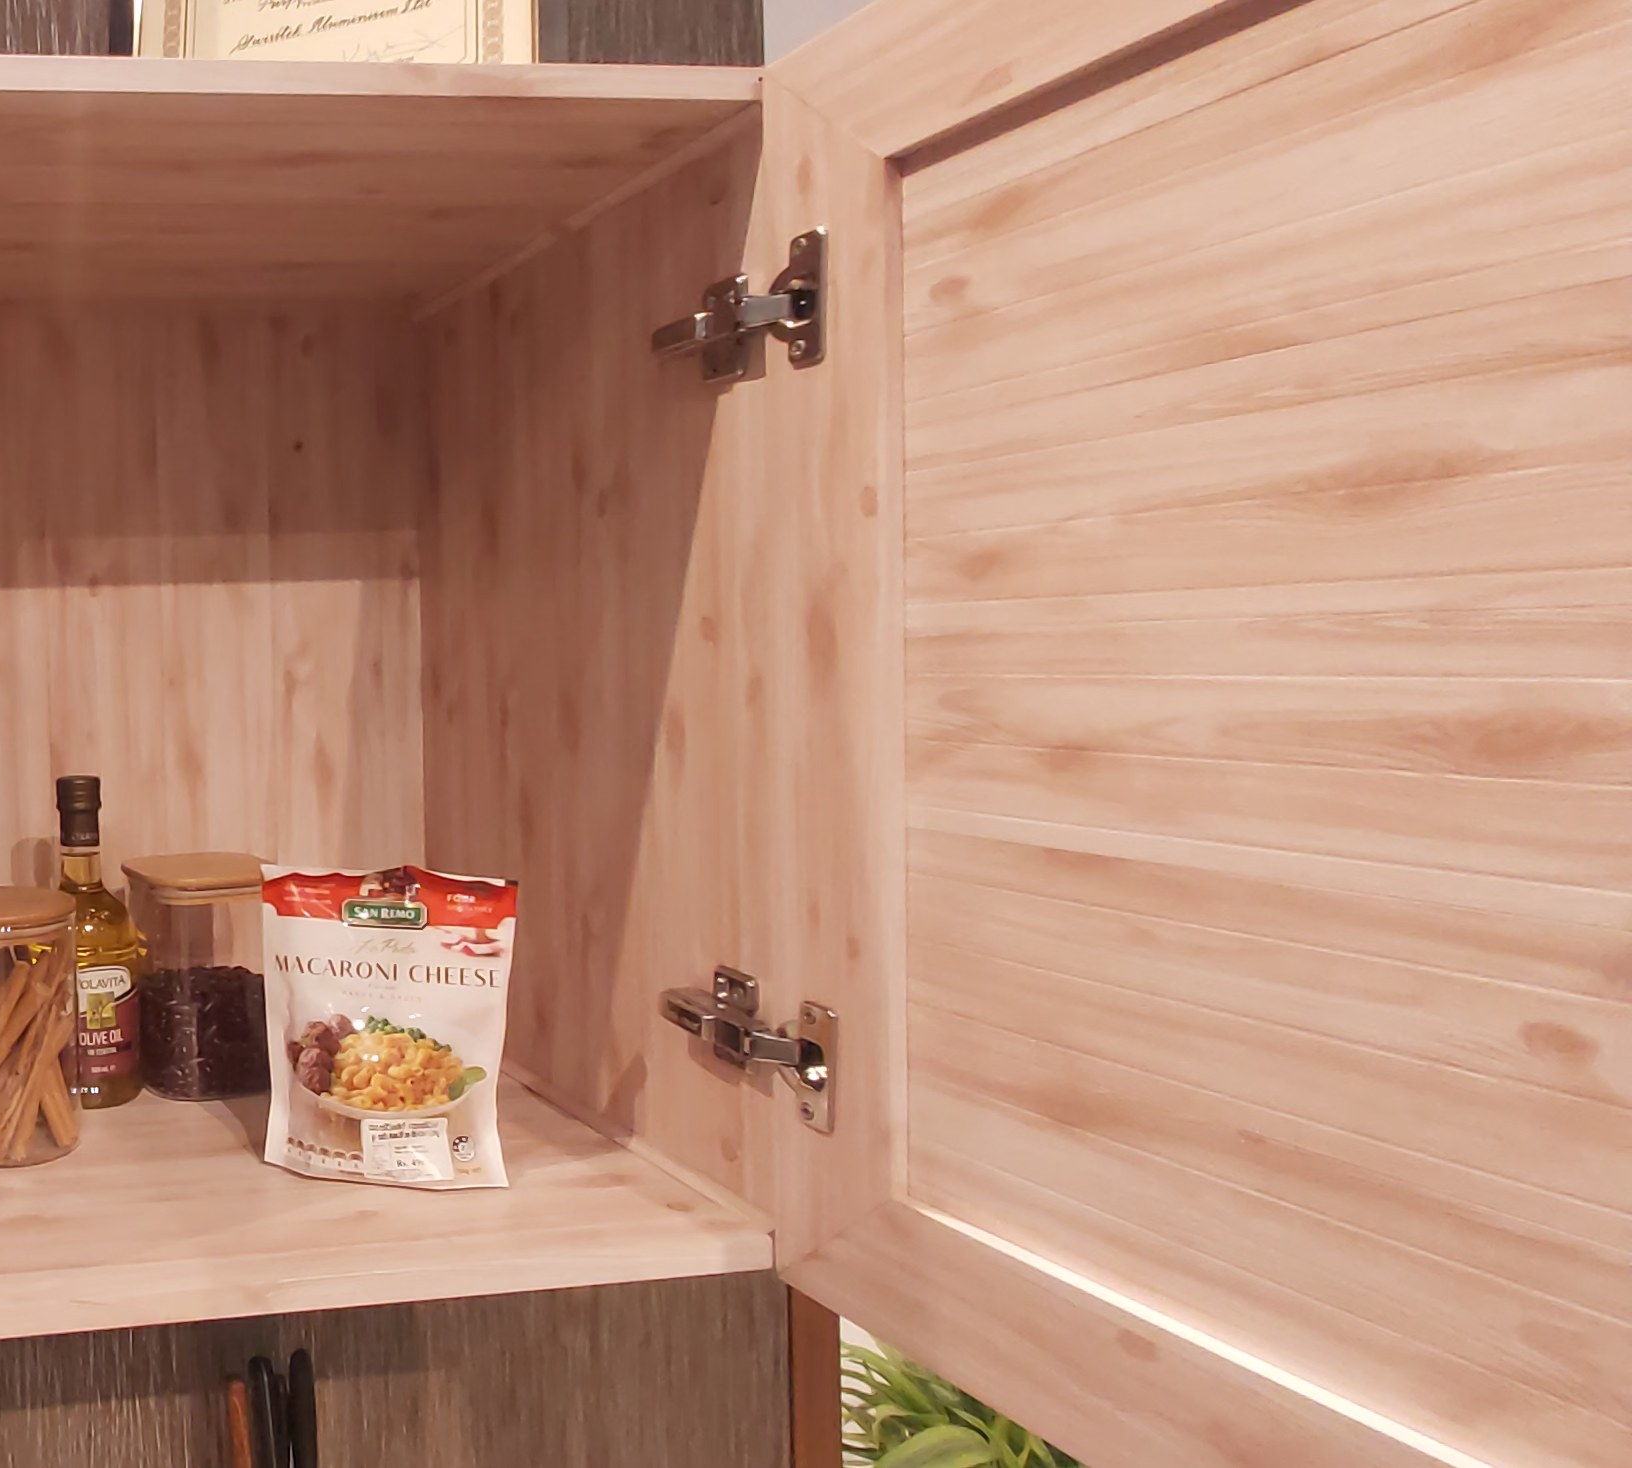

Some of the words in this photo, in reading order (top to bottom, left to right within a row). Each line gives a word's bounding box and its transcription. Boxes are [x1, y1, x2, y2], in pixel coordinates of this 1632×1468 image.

[353, 905, 378, 919] SAN
[380, 906, 415, 920] REMO
[274, 954, 399, 982] MACARONI
[408, 964, 501, 989] CHEESE
[78, 975, 127, 990] OLAVITA
[79, 1031, 108, 1046] OLIVE
[109, 1028, 125, 1043] OIL
